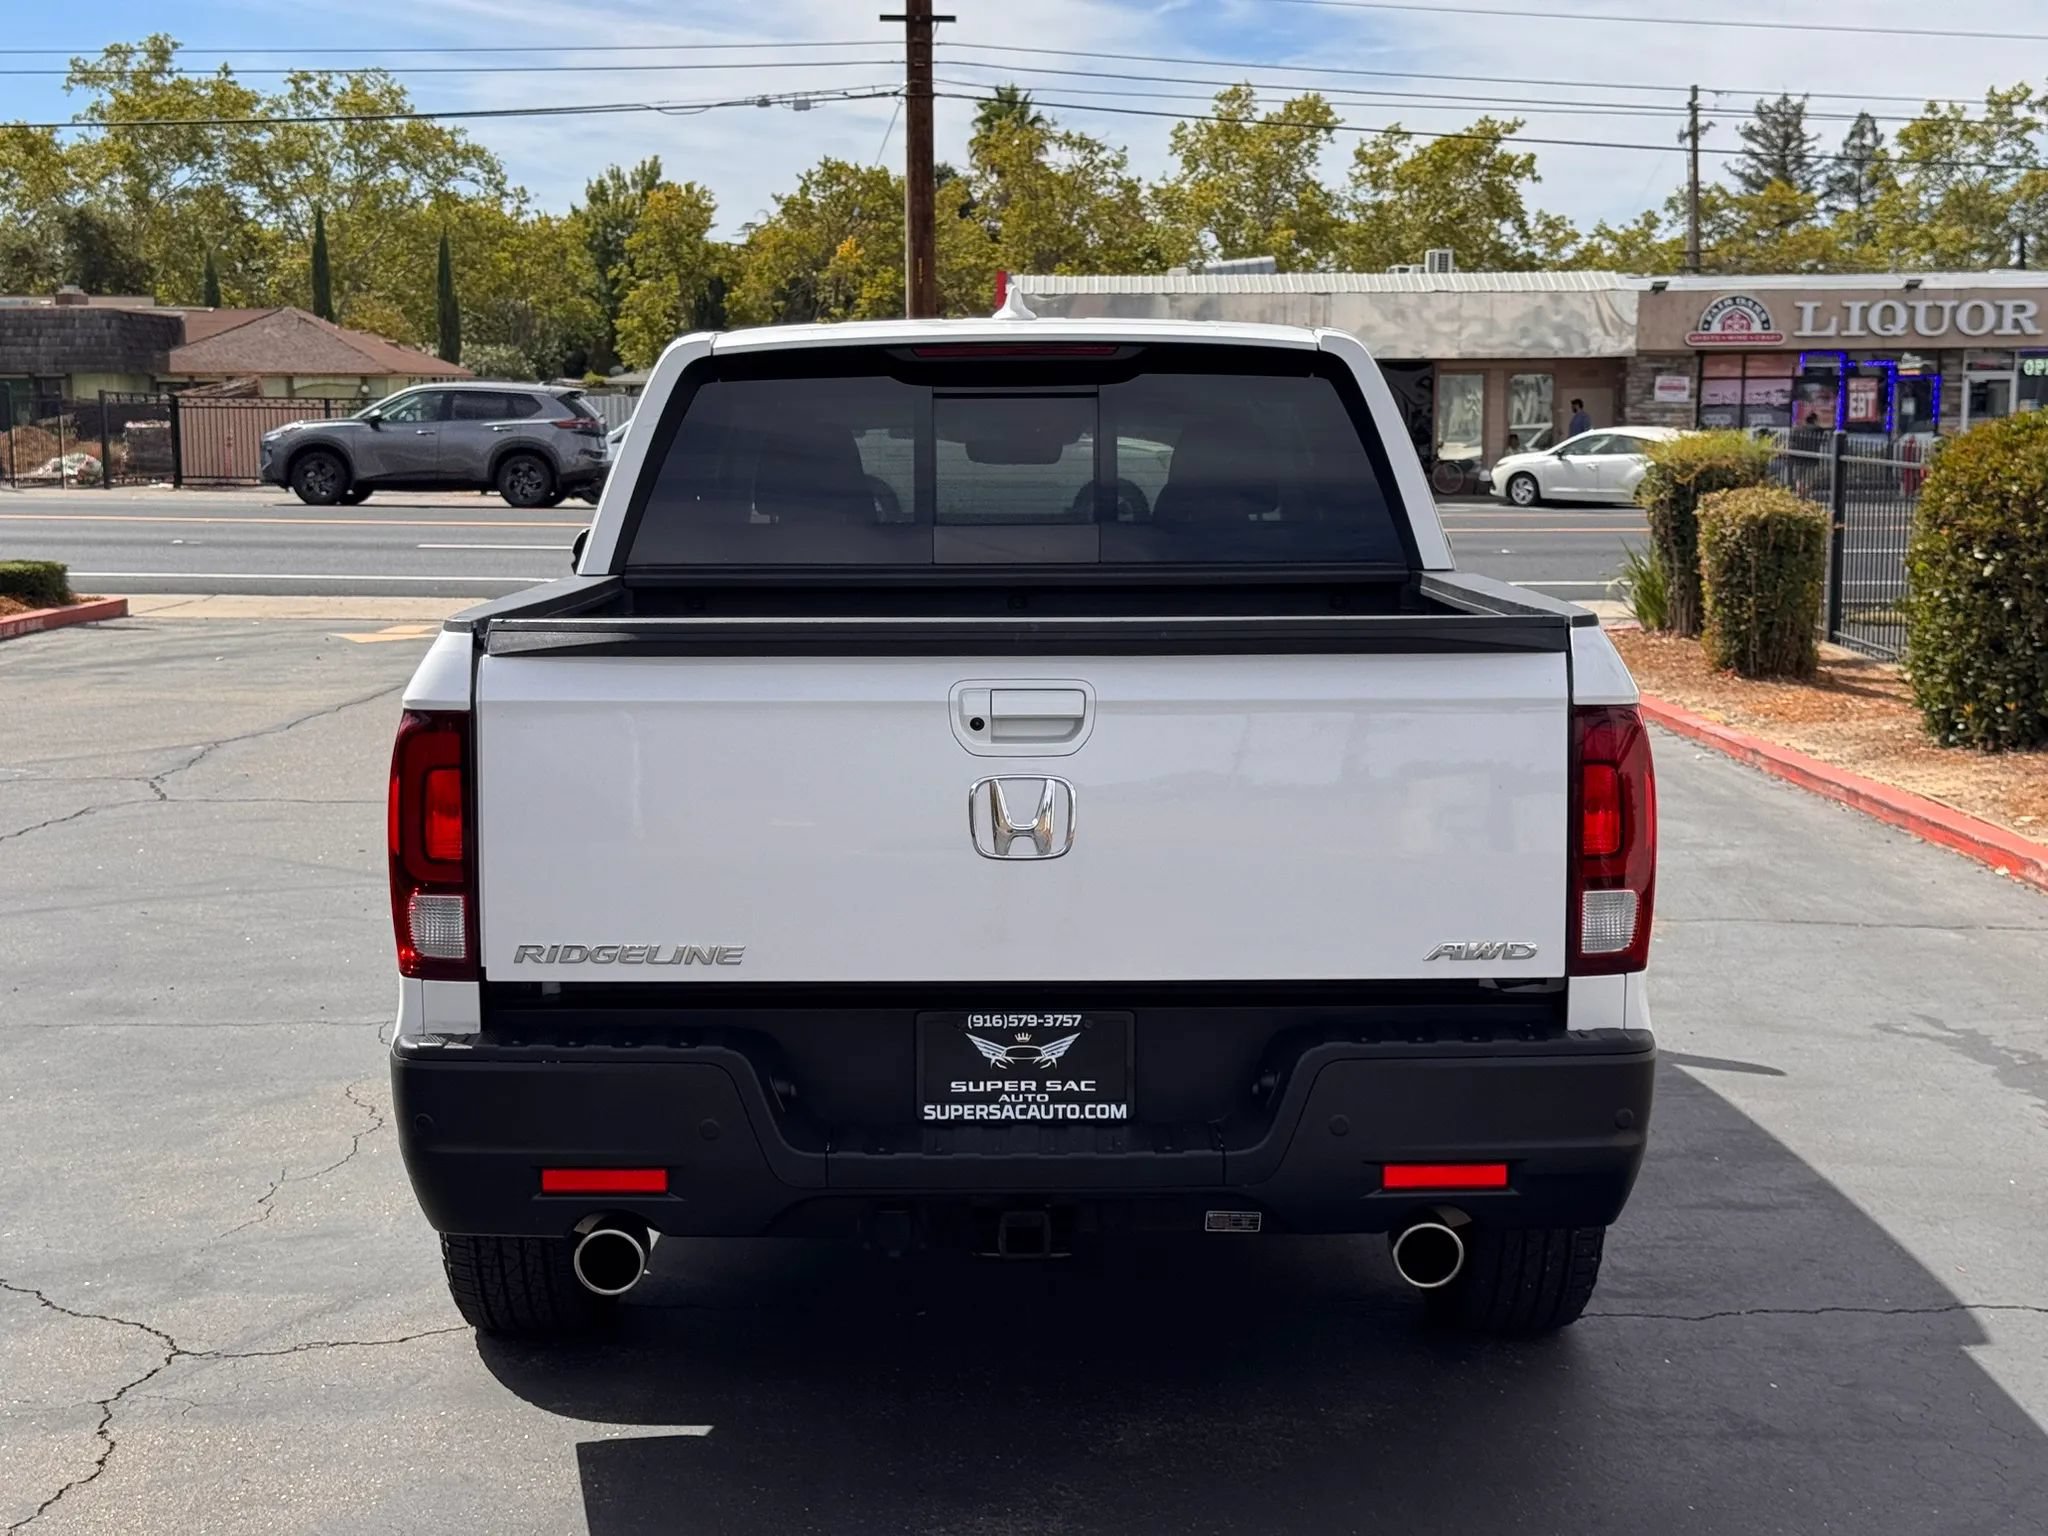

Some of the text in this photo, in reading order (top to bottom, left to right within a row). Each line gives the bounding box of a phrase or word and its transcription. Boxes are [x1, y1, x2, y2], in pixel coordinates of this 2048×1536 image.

[1793, 300, 2043, 336] LIQUOR
[514, 943, 746, 965] RIDGELINE
[1423, 942, 1538, 961] AWD
[967, 1014, 1082, 1029] (916)579-3757
[950, 1080, 1096, 1092] SUPER SAC
[998, 1094, 1049, 1102] AUTO
[924, 1104, 1127, 1120] SUPERSACAUTO.COM
